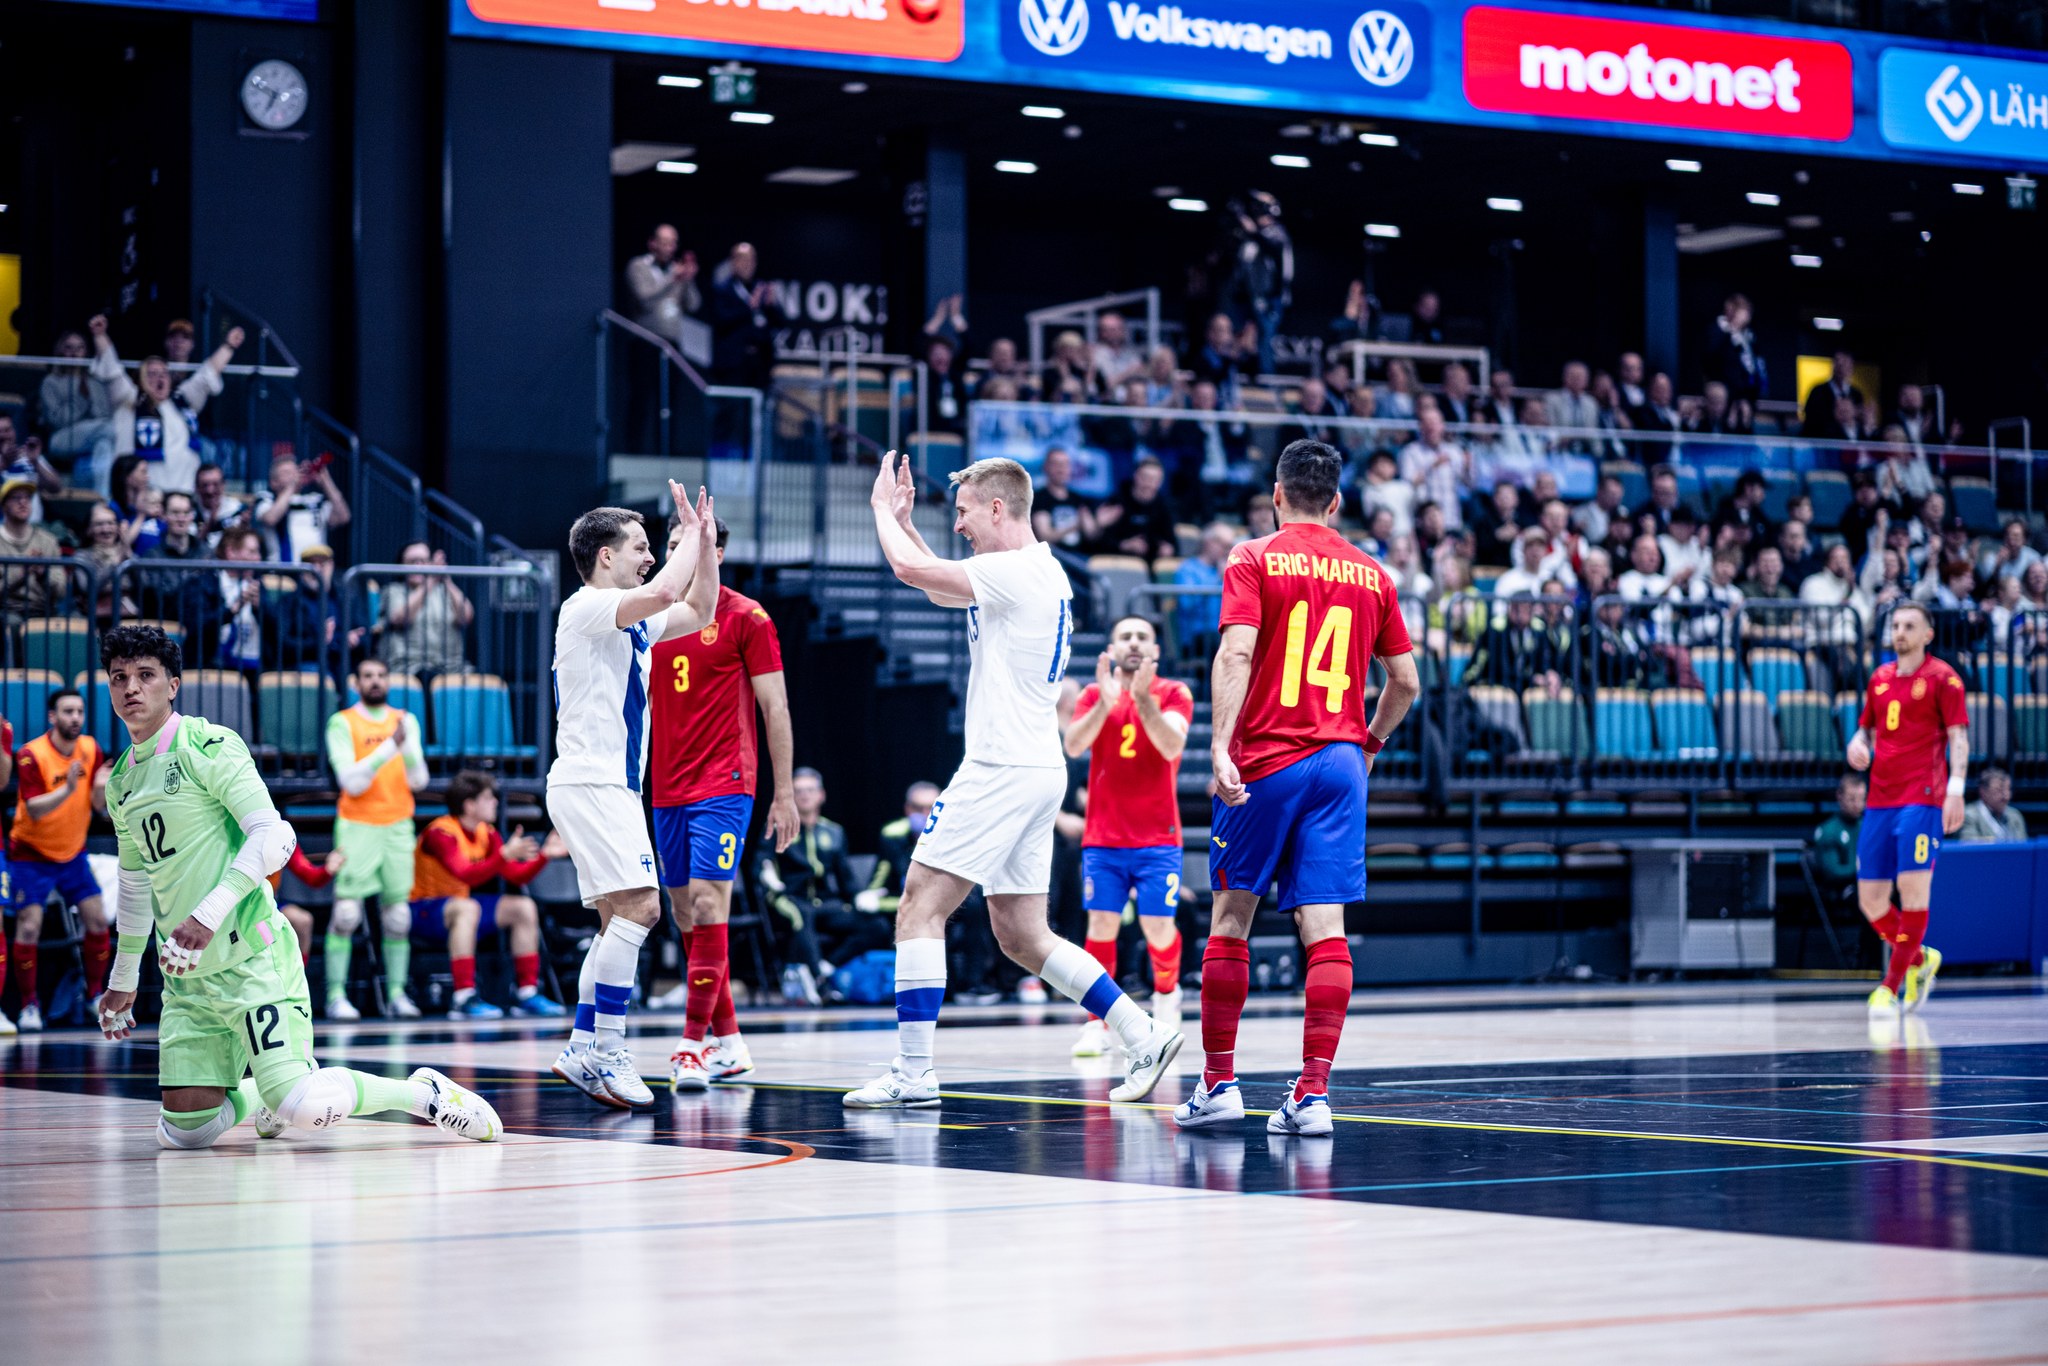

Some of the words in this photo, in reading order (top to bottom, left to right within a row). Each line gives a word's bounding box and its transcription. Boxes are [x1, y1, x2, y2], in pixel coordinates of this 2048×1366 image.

[1108, 2, 1333, 64] Volkswagen
[1519, 43, 1801, 113] motonet
[1989, 83, 2048, 129] LÄH
[1265, 552, 1310, 577] ERIC
[1312, 555, 1382, 595] MARTEL
[672, 655, 690, 692] 3
[1279, 600, 1353, 714] 14
[1886, 700, 1901, 731] 8
[1119, 723, 1137, 758] 2
[141, 812, 176, 863] 12
[717, 832, 737, 870] 3
[1914, 833, 1930, 864] 8
[1164, 872, 1180, 908] 2
[245, 1004, 285, 1056] 12
